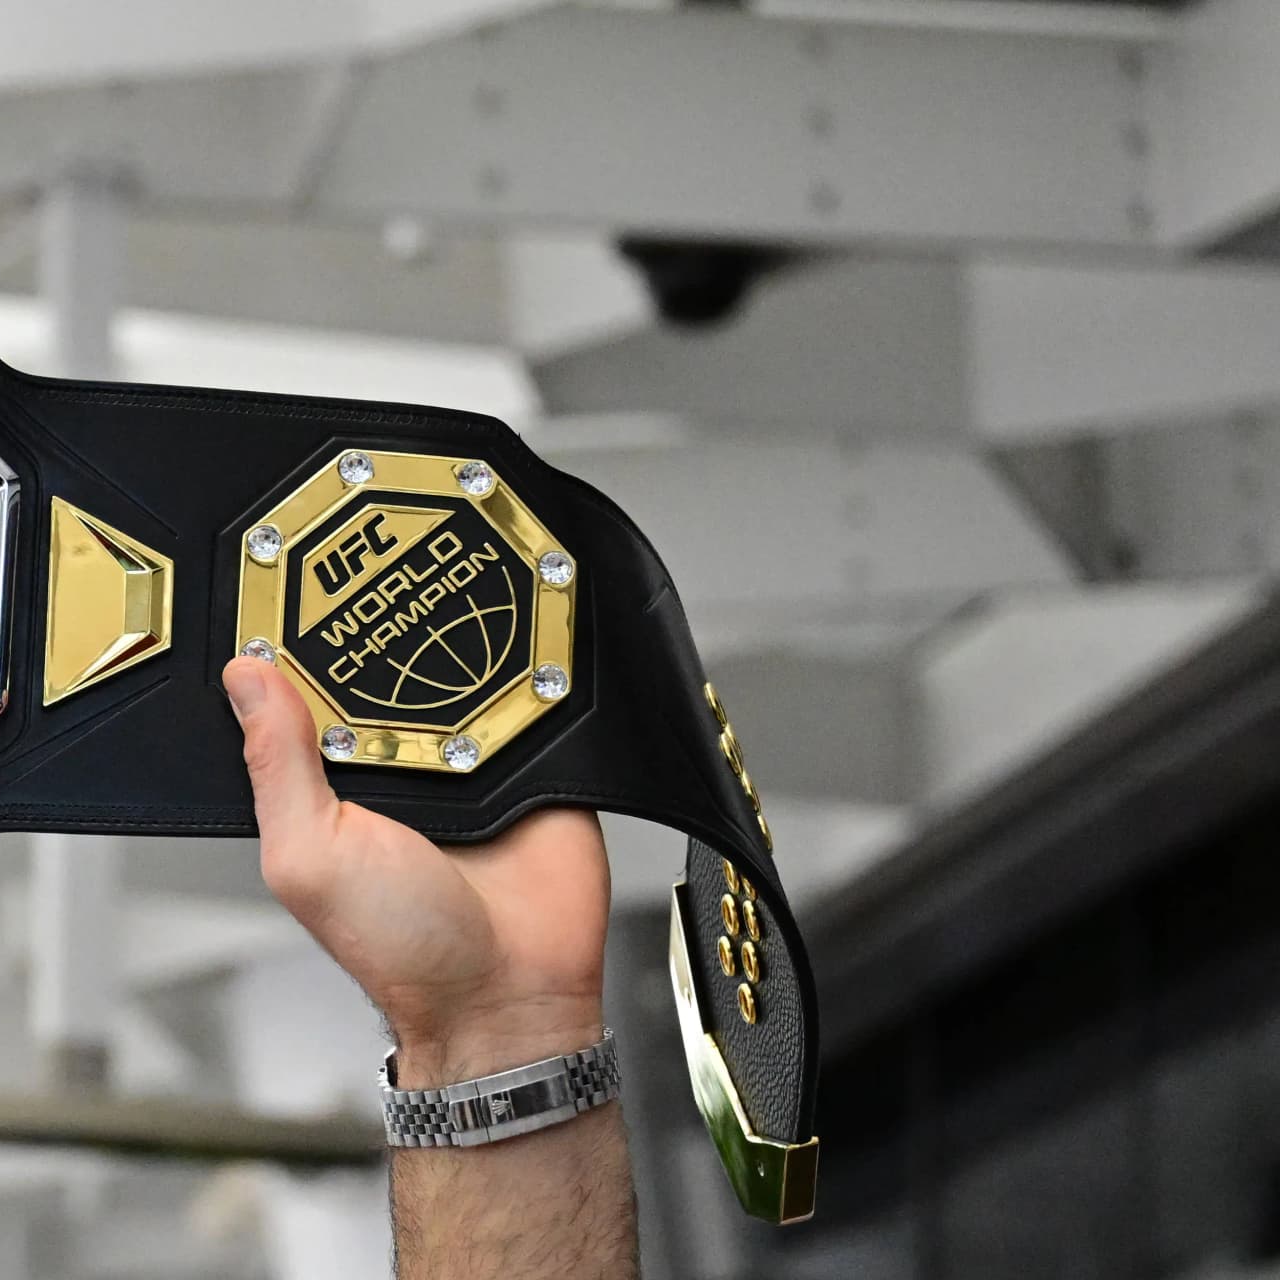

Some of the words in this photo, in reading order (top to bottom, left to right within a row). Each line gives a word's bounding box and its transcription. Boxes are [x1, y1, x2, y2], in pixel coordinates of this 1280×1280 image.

[312, 513, 398, 597] UFC
[320, 530, 463, 647] WORLD
[327, 542, 500, 684] CHAMPION
